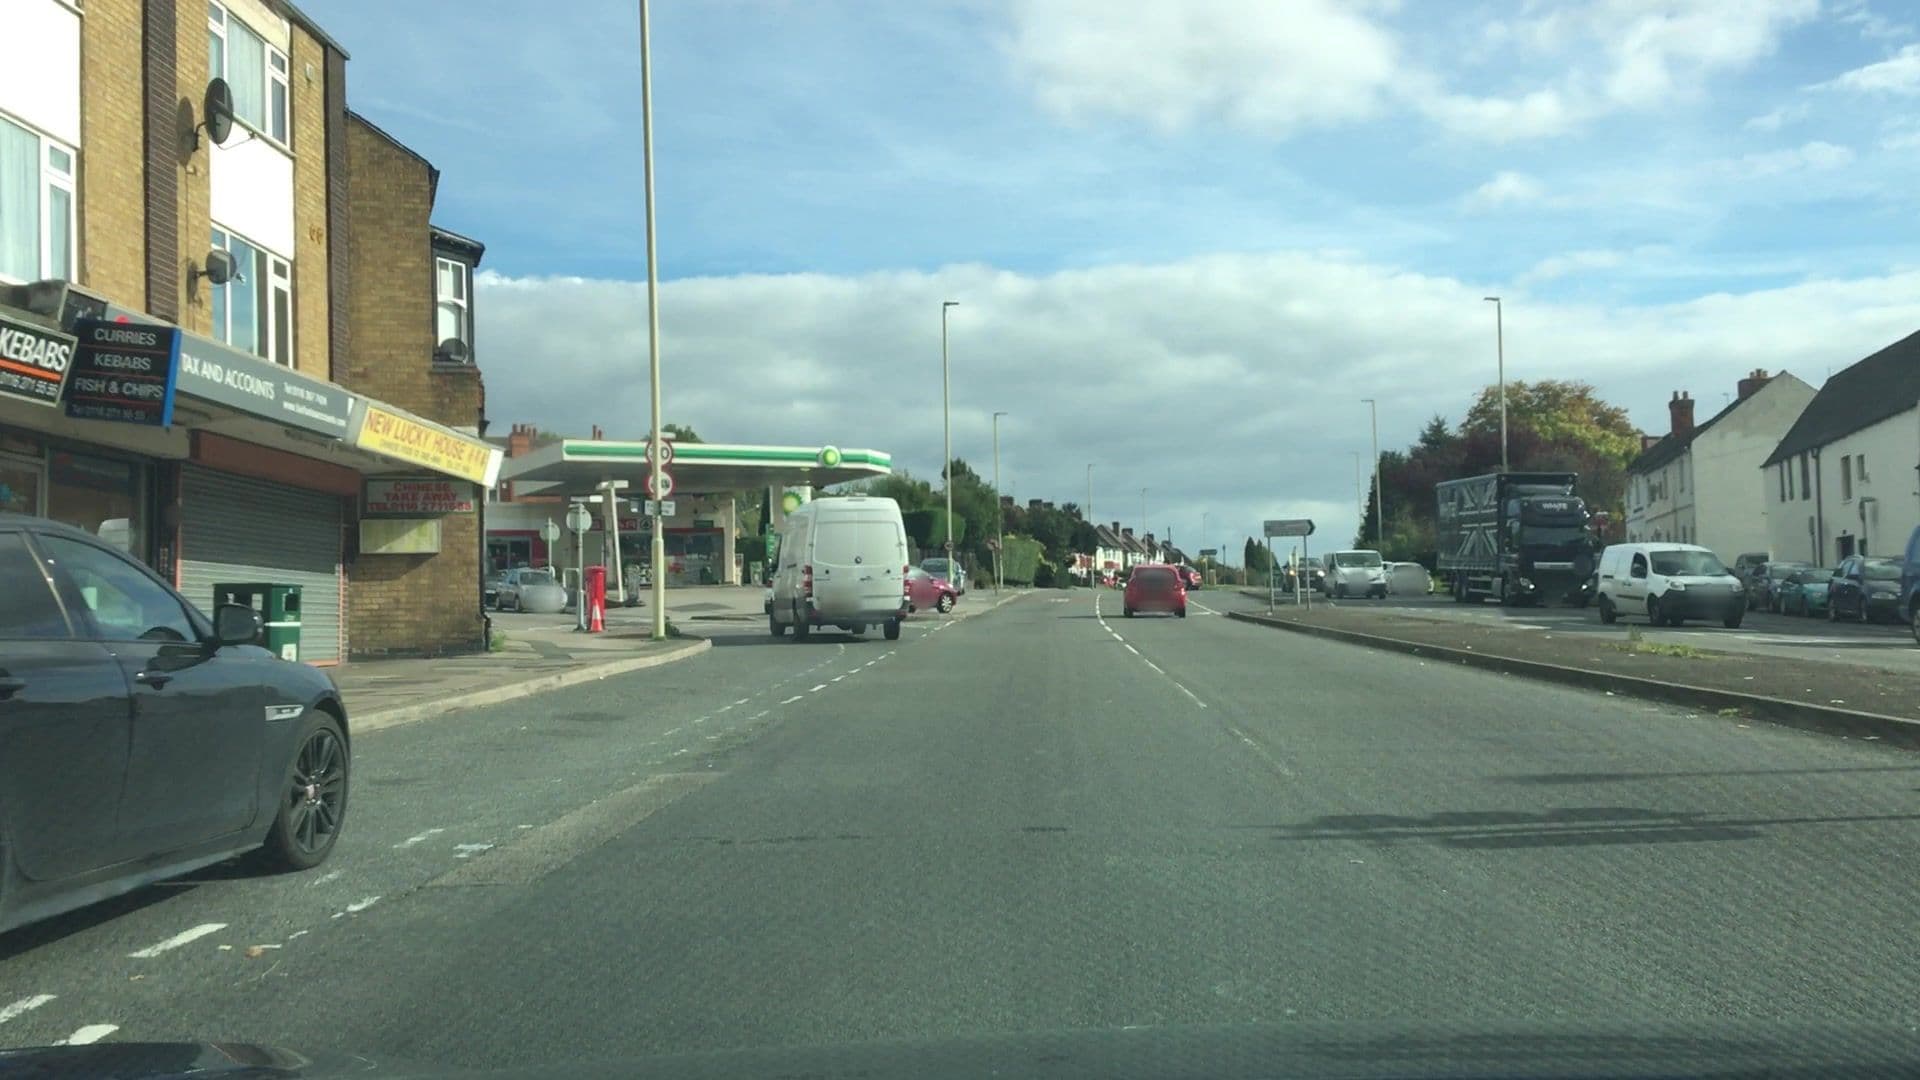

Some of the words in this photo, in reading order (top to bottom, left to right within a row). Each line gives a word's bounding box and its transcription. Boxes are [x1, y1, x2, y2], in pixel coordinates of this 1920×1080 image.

[94, 328, 157, 346] CURRIES
[0, 327, 69, 371] KEBABS
[94, 353, 152, 370] KEBABS
[181, 353, 200, 376] TAX
[202, 361, 223, 384] AND
[225, 370, 275, 401] ACCOUNTS
[74, 377, 105, 393] FISH
[108, 381, 120, 394] &
[122, 382, 164, 399] CHIPS
[366, 410, 394, 435] NEW
[394, 420, 432, 446] LUCKY
[433, 434, 467, 461] HOUSE
[384, 492, 417, 502] TAKE
[422, 492, 457, 502] AWAY
[394, 482, 450, 492] CHINESE
